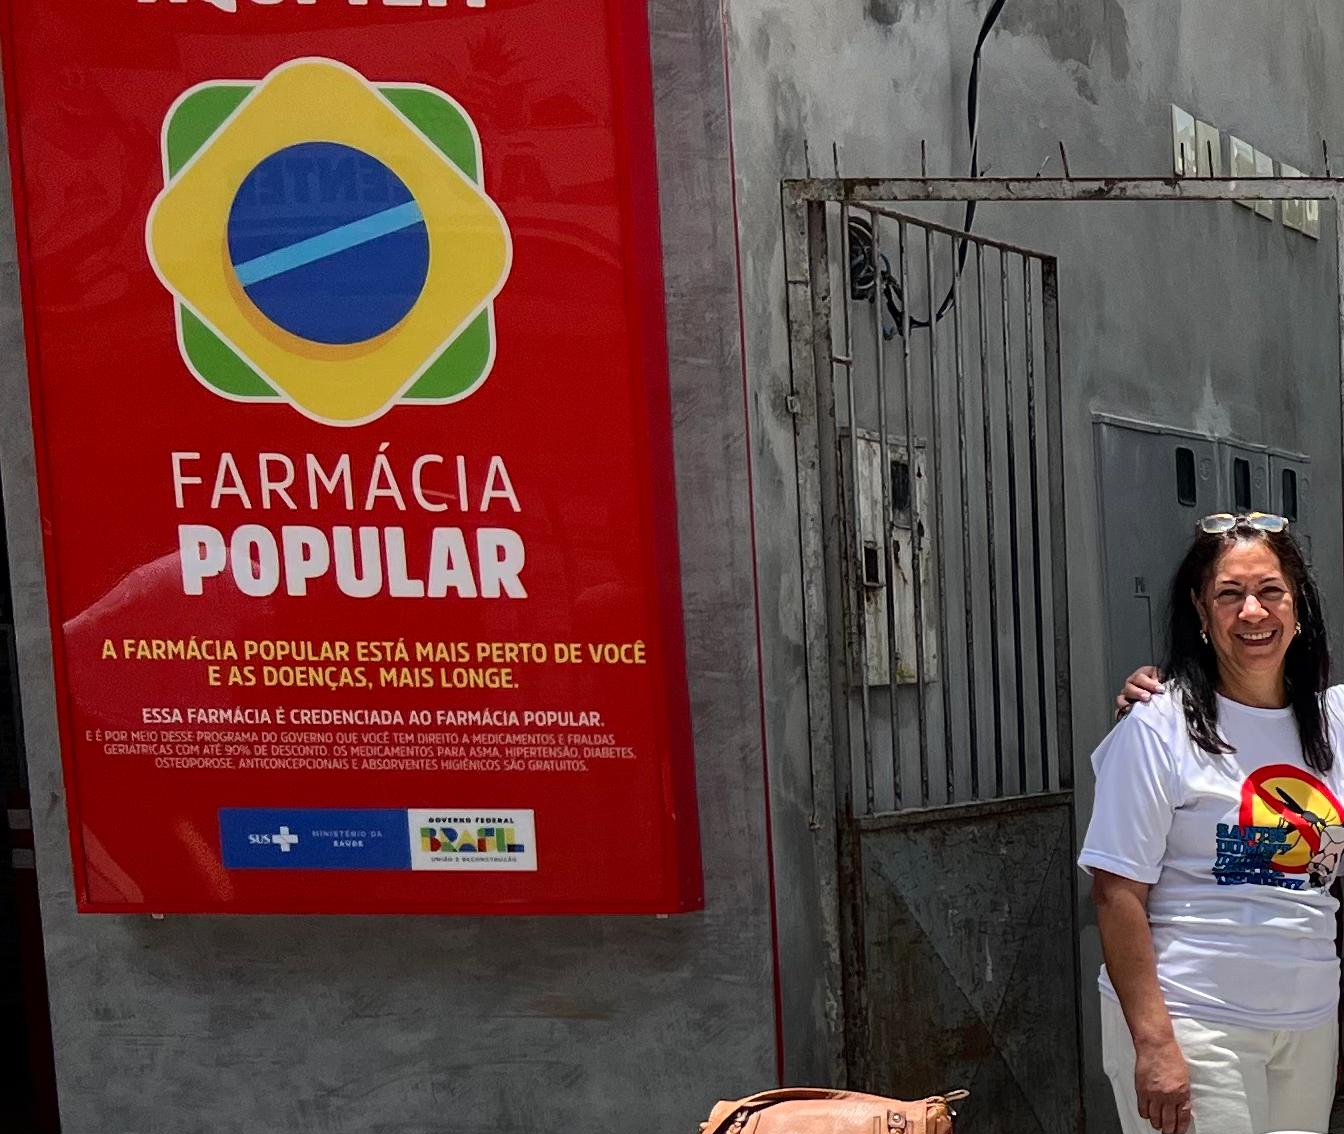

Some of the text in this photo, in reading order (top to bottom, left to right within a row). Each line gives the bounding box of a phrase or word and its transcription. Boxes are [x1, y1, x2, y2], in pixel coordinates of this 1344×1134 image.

[171, 443, 521, 512] FARMÁCIA
[178, 525, 527, 599] POPULAR
[102, 636, 646, 664] A FARMÁCIA POPULAR ESTÁ MAIS PERTO DE VOCÊ
[208, 666, 519, 690] E AS DOENÇAS, MAIS LONGE.
[143, 706, 604, 727] ESSA FARMÁCIA É CREDENCIADA AO FARMÁCIA POPULAR.
[248, 835, 271, 845] SUS
[420, 827, 525, 853] BRASIL
